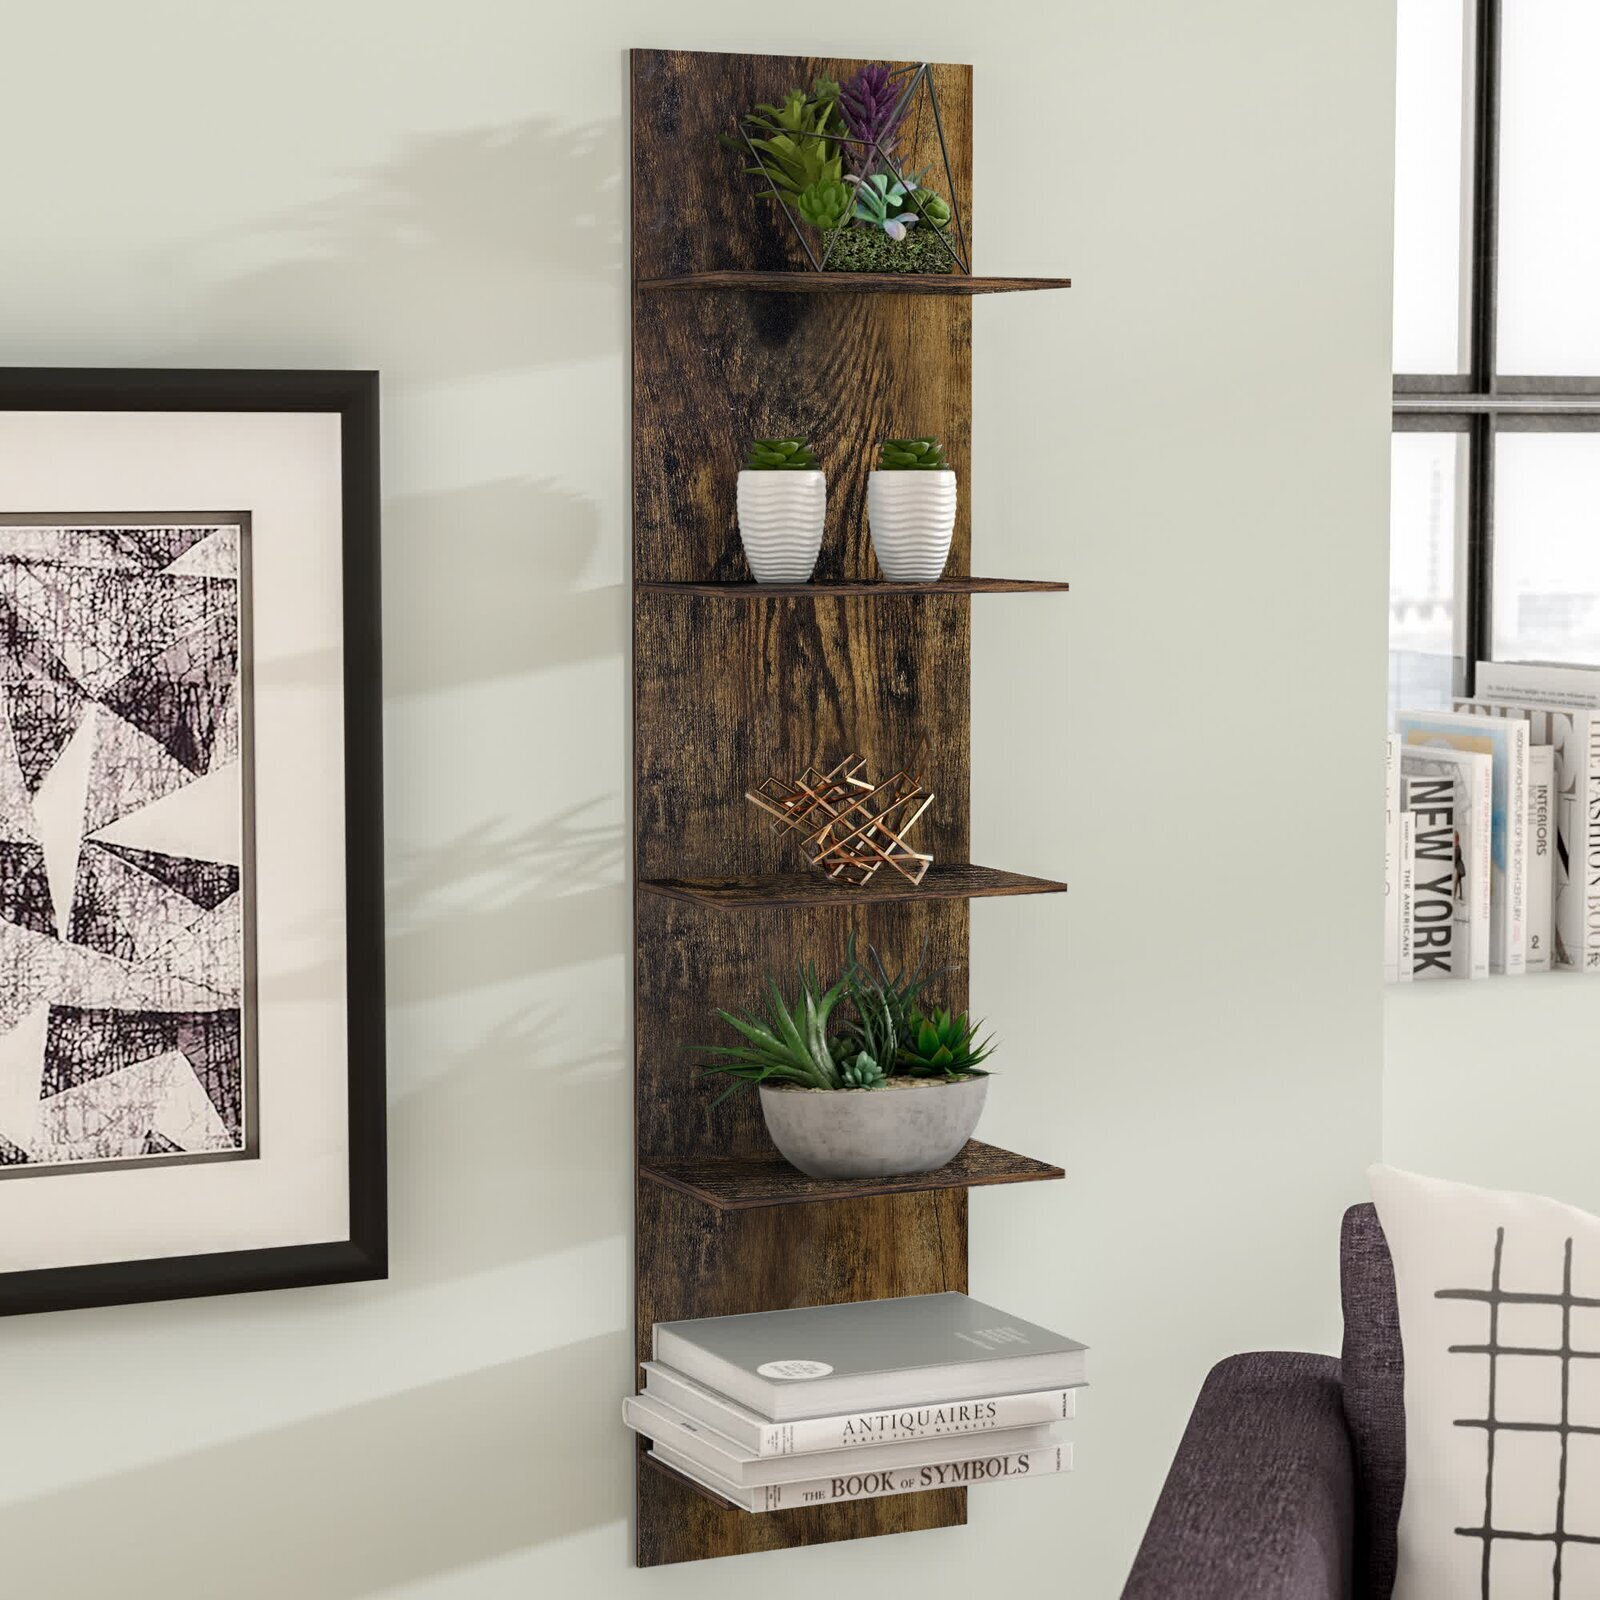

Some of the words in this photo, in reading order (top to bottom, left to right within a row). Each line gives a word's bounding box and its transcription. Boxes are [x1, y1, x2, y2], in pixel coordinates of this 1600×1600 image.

[1410, 779, 1454, 862] NEW
[1536, 784, 1548, 857] INTERIORS
[1403, 869, 1411, 890] THE
[1402, 894, 1410, 958] AMERICANS
[1412, 874, 1453, 974] YORK
[1531, 934, 1540, 949] 2
[842, 1401, 997, 1436] ANTIQUAIRES
[802, 1488, 826, 1502] THE
[831, 1471, 895, 1499] BOOK
[900, 1478, 916, 1489] OF
[919, 1454, 1030, 1487] SYMBOLS
